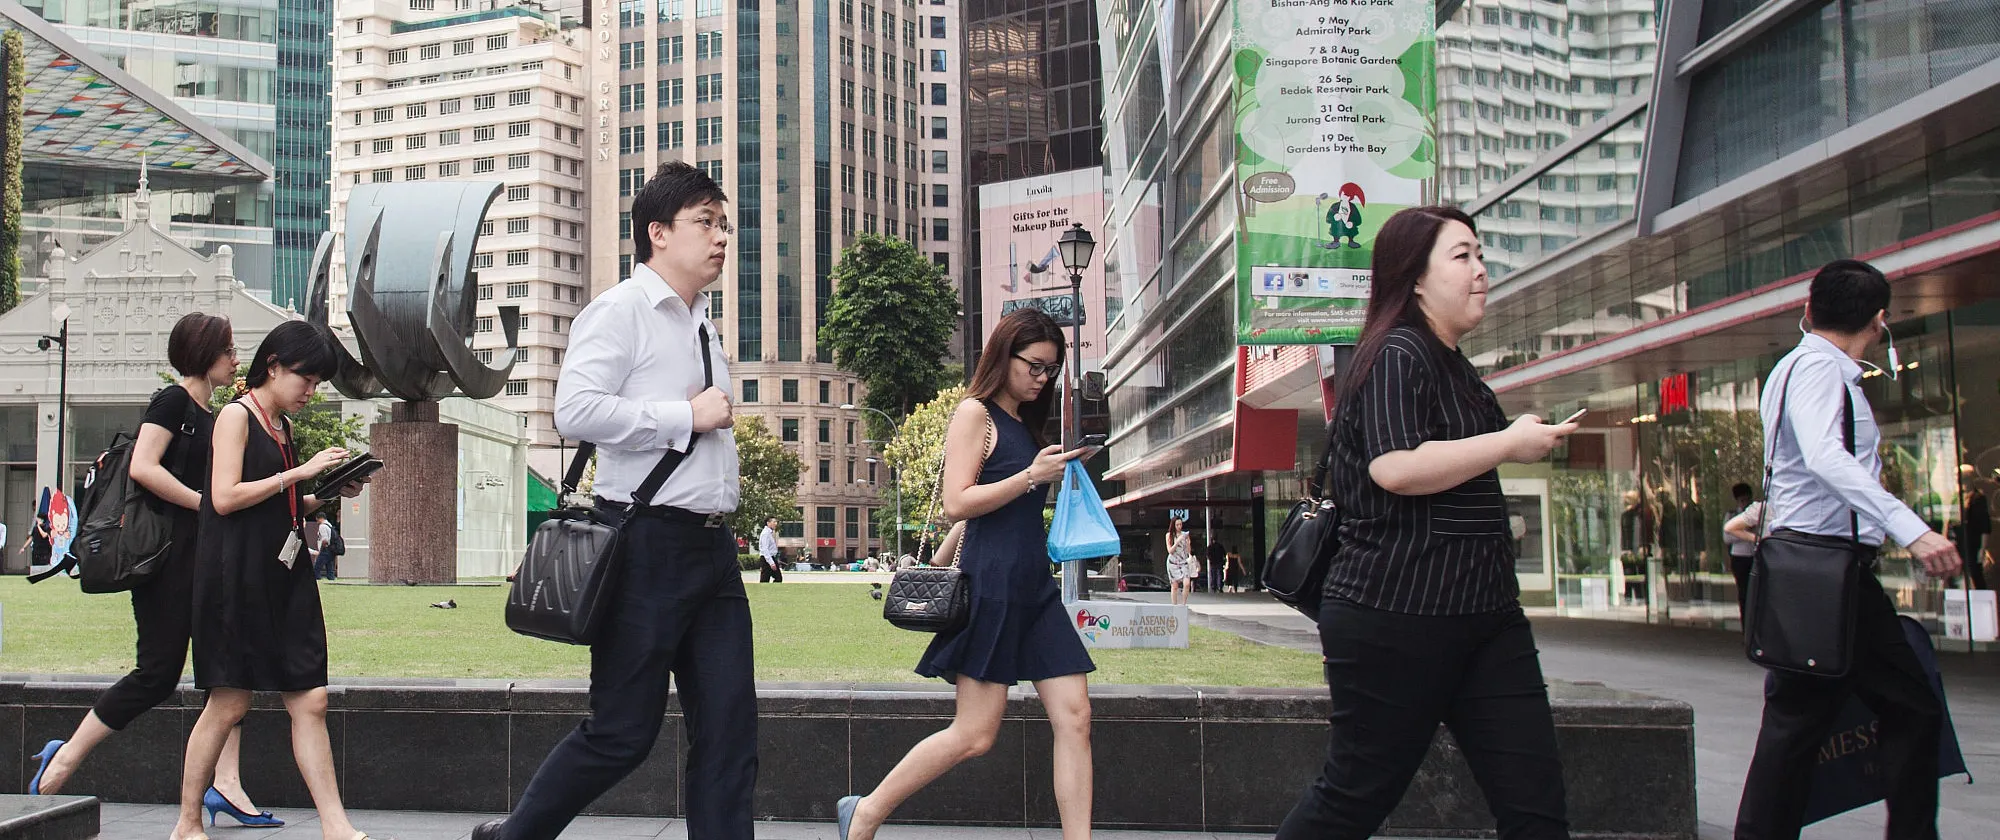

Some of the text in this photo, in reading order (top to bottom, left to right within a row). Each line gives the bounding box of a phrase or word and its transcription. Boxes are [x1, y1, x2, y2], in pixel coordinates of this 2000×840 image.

[1318, 16, 1350, 26] 9 May
[1296, 26, 1372, 36] Admiralty Park
[1309, 45, 1360, 56] 7 & 8 Aug
[1265, 55, 1402, 68] Singapore Botanic Gardens
[1319, 74, 1353, 85] 26 Sep
[1280, 84, 1390, 95] Bedok Reservoir Park
[1320, 104, 1353, 113] 31 Oct
[598, 81, 611, 162] GREEN
[1285, 114, 1386, 125] Jurong Central Park
[1321, 133, 1354, 142] 19 Dec
[1286, 143, 1387, 154] Gardens by the Bay
[1261, 176, 1279, 185] Free
[1249, 185, 1290, 194] Admission
[1013, 207, 1069, 221] Gifts for the
[1012, 217, 1070, 233] Makeup Buff
[1140, 615, 1166, 626] ASEAN
[1111, 626, 1167, 637] PARA GAMES
